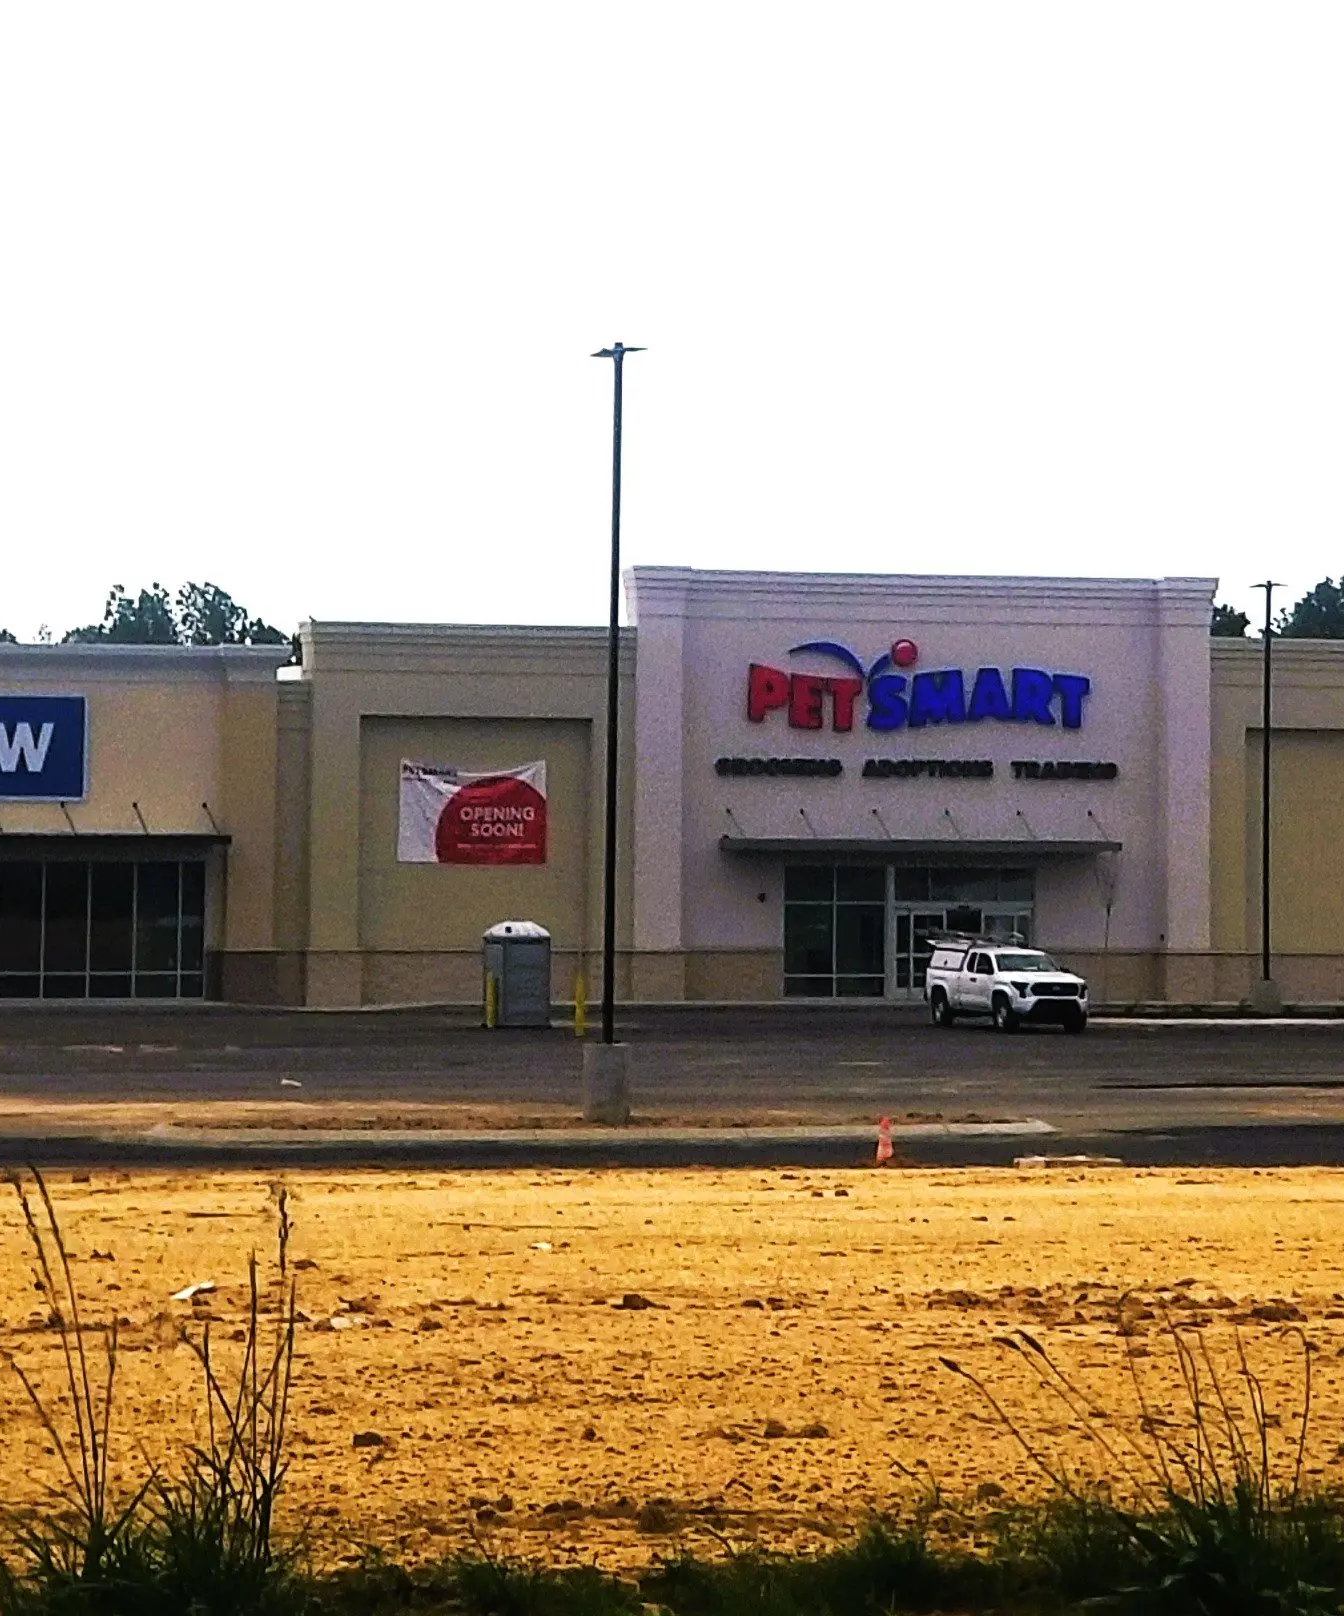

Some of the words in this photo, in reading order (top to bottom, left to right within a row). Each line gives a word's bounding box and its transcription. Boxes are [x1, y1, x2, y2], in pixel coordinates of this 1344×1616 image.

[747, 663, 1091, 732] PETSMART
[460, 806, 535, 821] OPENING
[471, 823, 524, 837] SOON!
